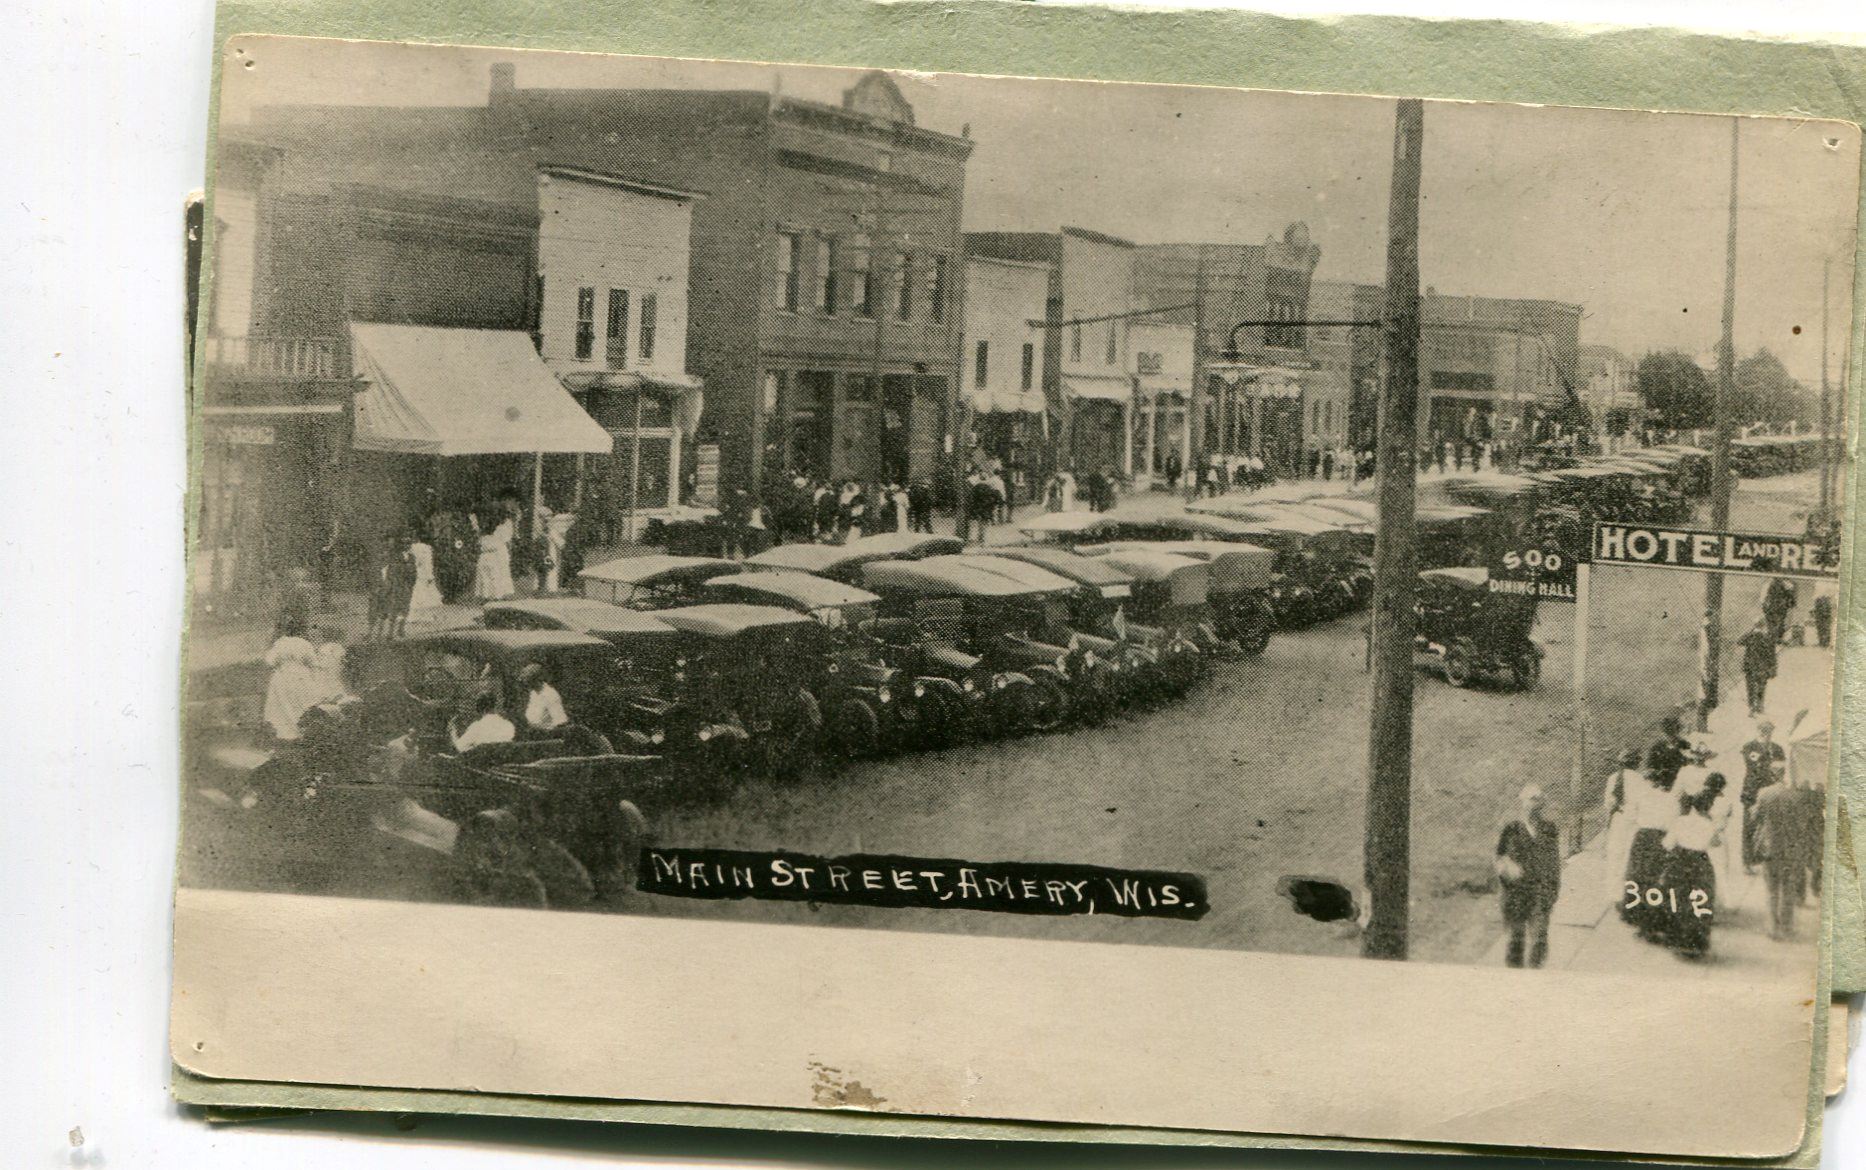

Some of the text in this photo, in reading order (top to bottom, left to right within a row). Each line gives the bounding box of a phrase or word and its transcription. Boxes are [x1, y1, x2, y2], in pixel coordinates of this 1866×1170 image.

[1601, 526, 1752, 568] HOTEL
[1738, 542, 1780, 559] AND
[1503, 549, 1562, 571] SOO
[1490, 579, 1574, 597] DINING HALL
